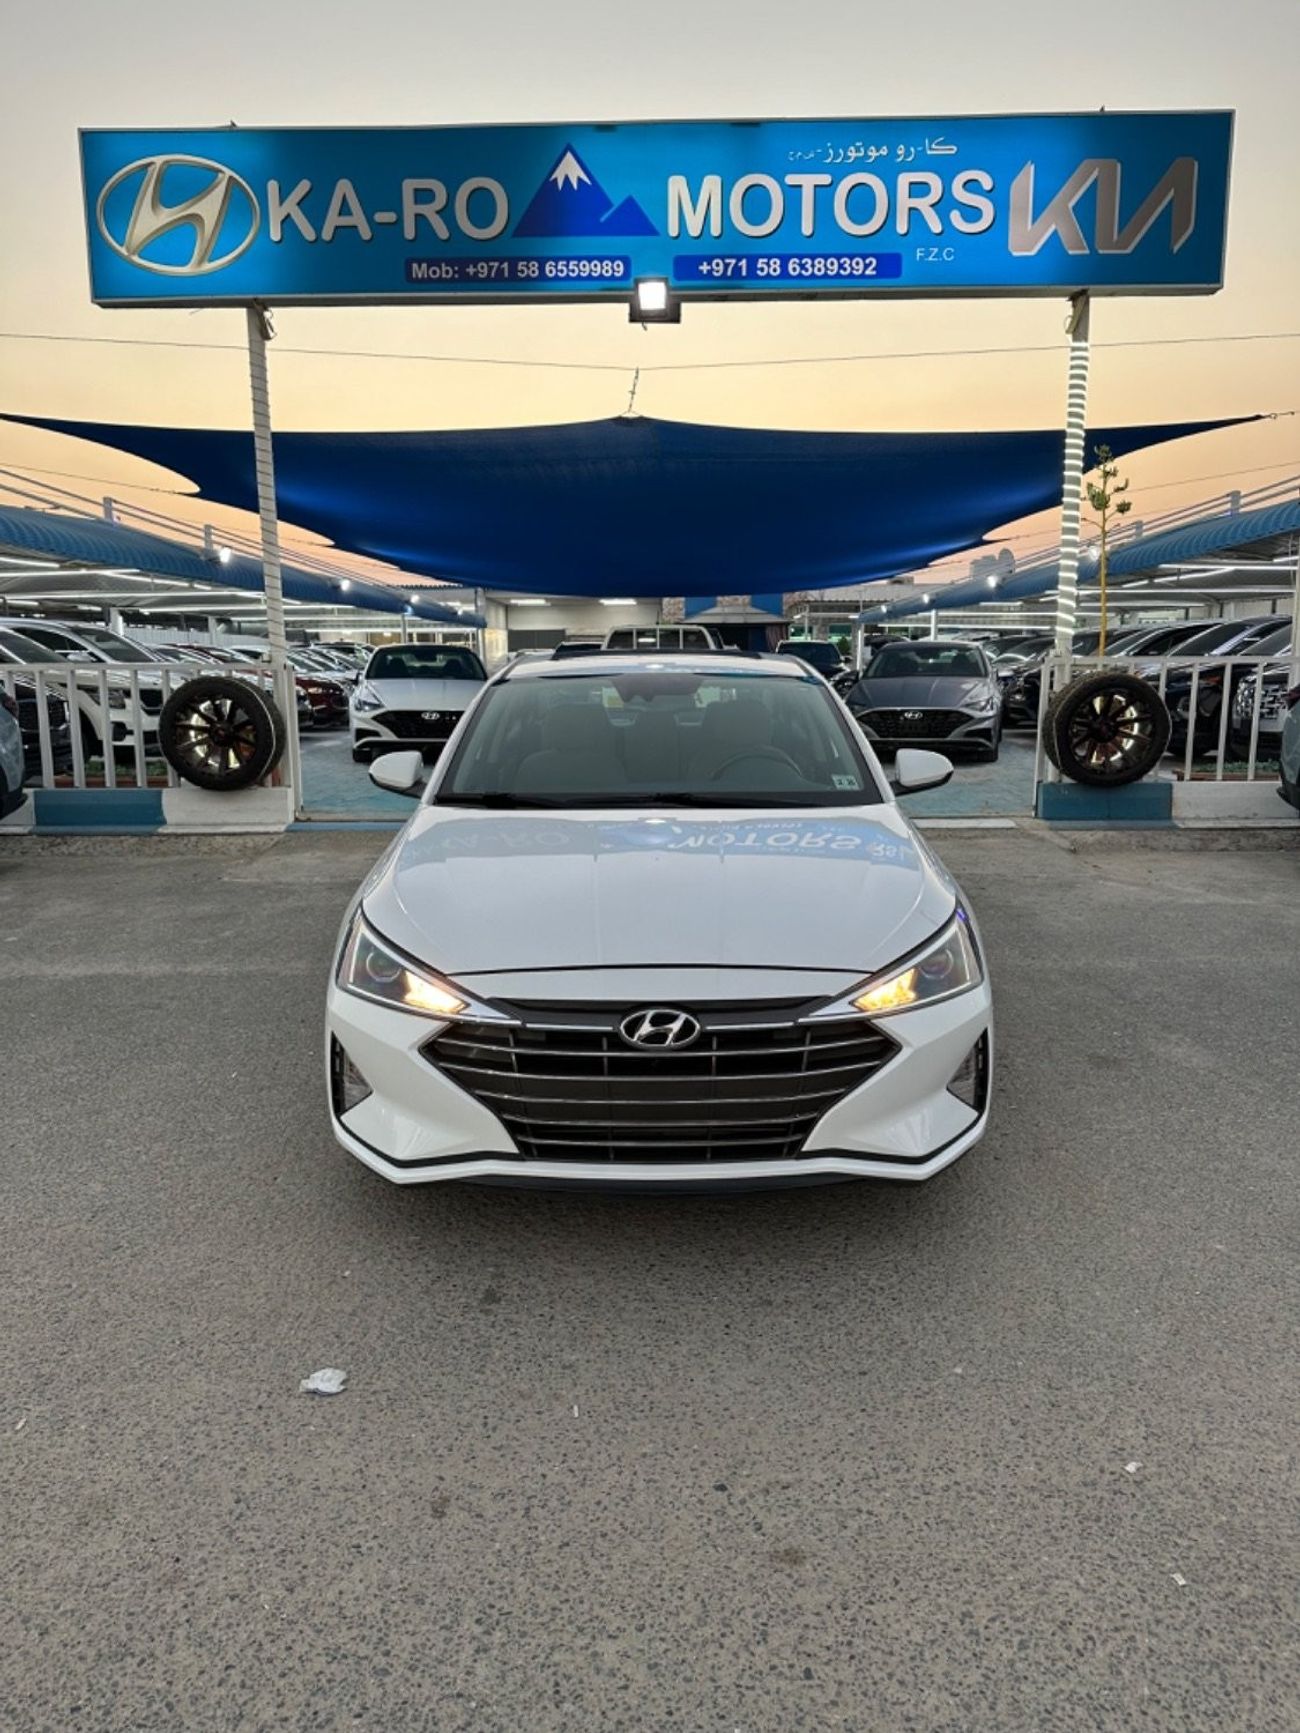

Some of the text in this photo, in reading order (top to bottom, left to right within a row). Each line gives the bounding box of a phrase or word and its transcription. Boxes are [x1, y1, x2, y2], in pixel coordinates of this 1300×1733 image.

[266, 170, 995, 242] KA-RO MOTORS
[915, 247, 955, 262] F.Z.C
[411, 259, 625, 279] Mob: +971 58 6559989
[698, 256, 878, 277] +971 58 6389392
